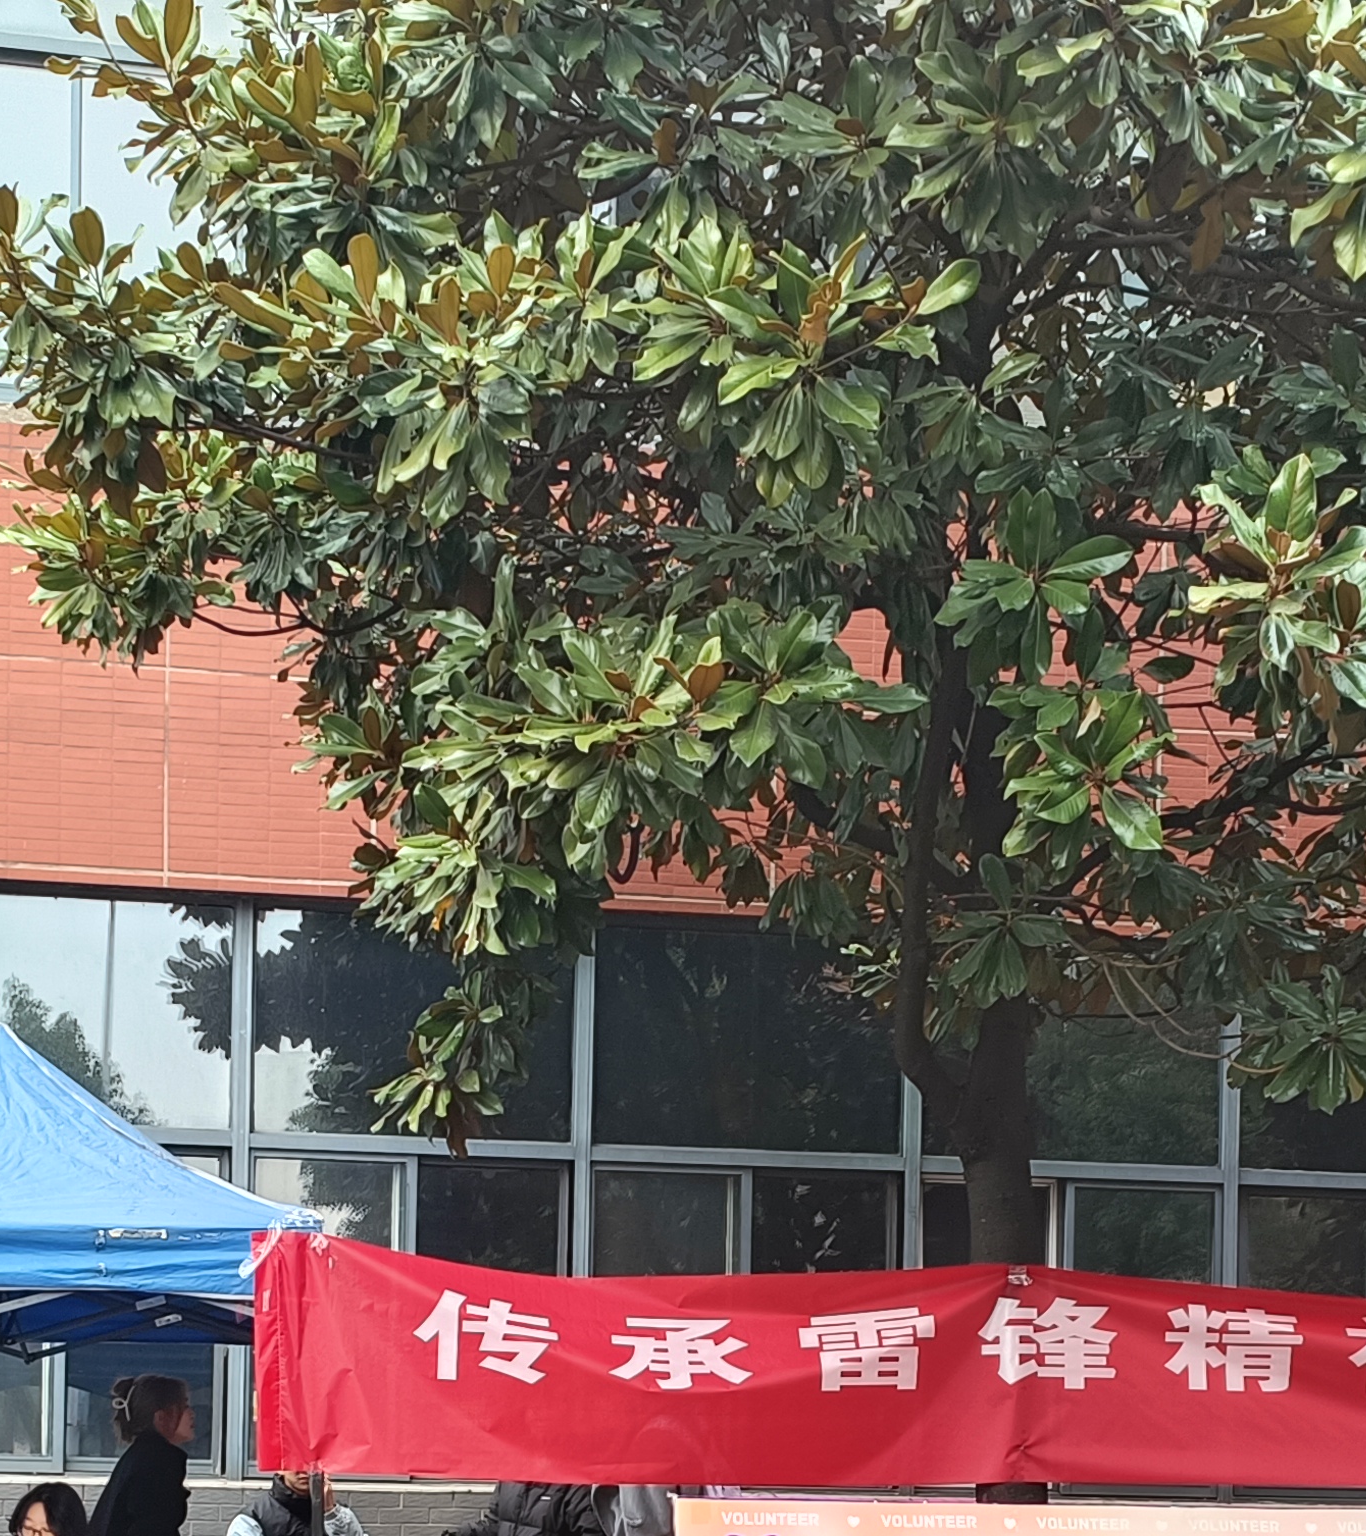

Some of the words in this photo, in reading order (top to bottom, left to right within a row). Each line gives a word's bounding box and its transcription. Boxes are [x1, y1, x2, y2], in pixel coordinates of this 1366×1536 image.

[721, 1511, 820, 1527] VOLUNTEER
[881, 1514, 977, 1529] VOLUNTEER
[1036, 1516, 1130, 1531] VOLUNTEER
[1188, 1519, 1281, 1533] VOLUNTEER
